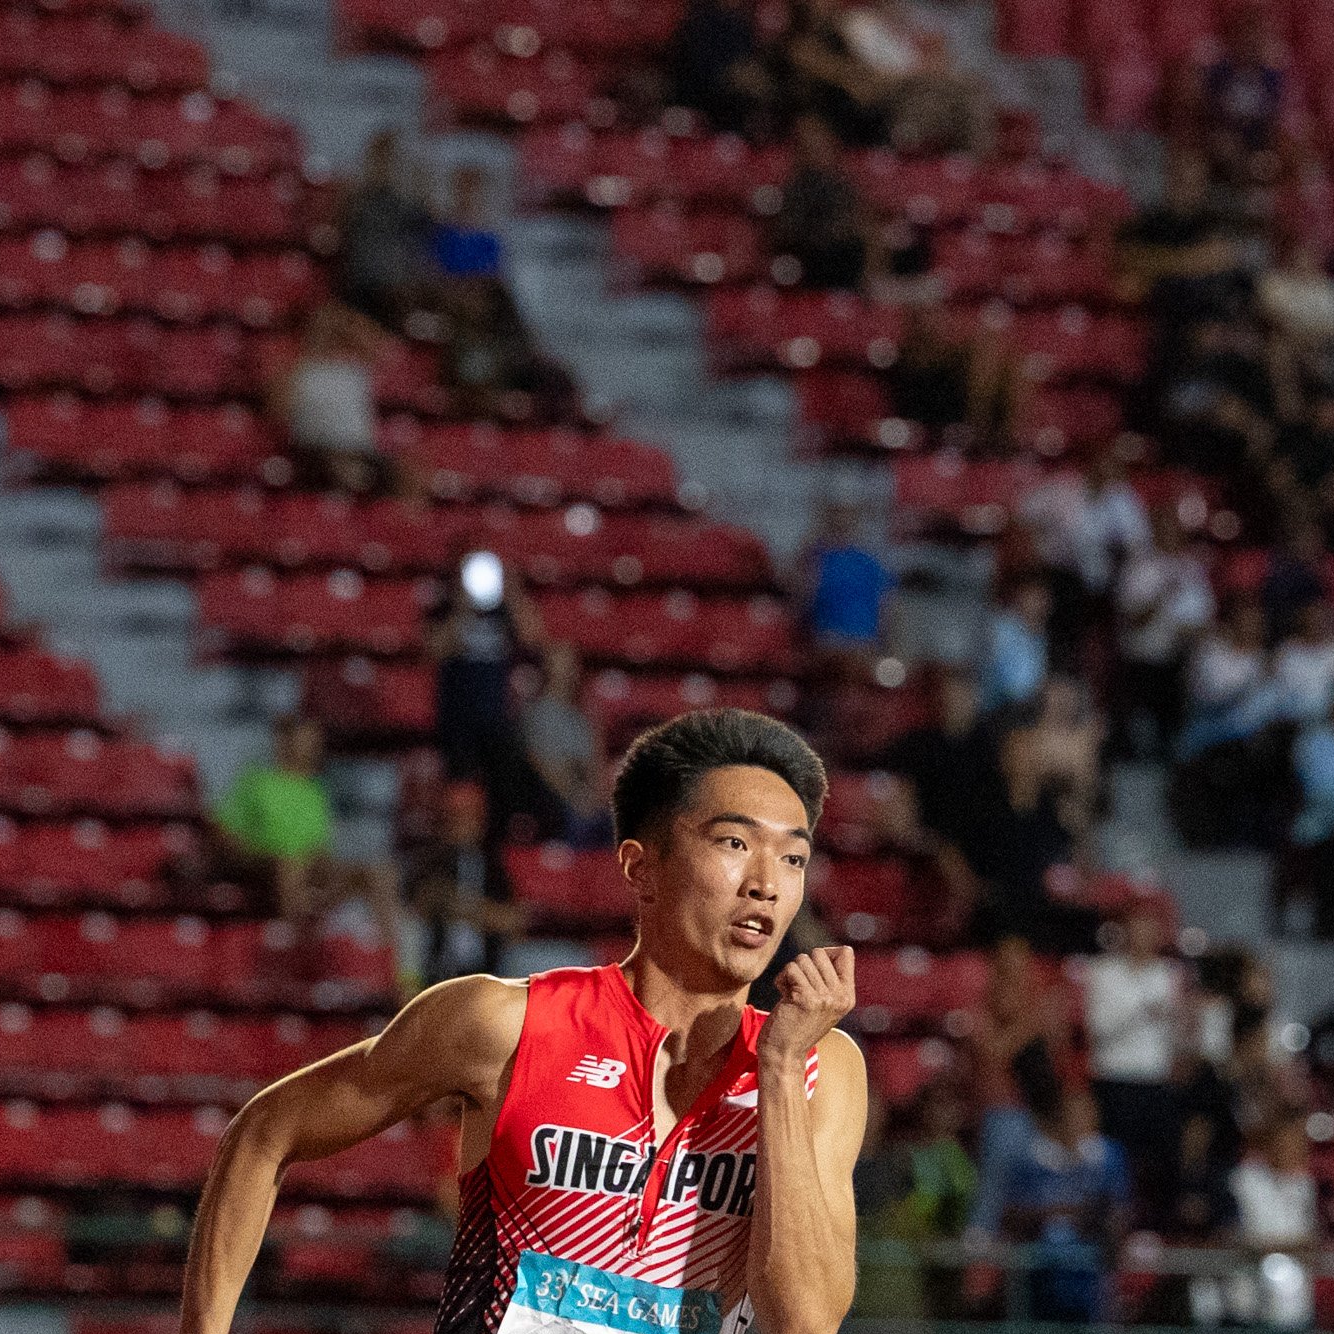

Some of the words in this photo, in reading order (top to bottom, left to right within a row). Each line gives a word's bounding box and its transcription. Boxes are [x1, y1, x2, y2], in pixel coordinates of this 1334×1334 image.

[566, 1054, 627, 1089] NB
[526, 1125, 757, 1217] SINGAPOR
[577, 1283, 619, 1315] SEA
[627, 1295, 701, 1330] GAMES
